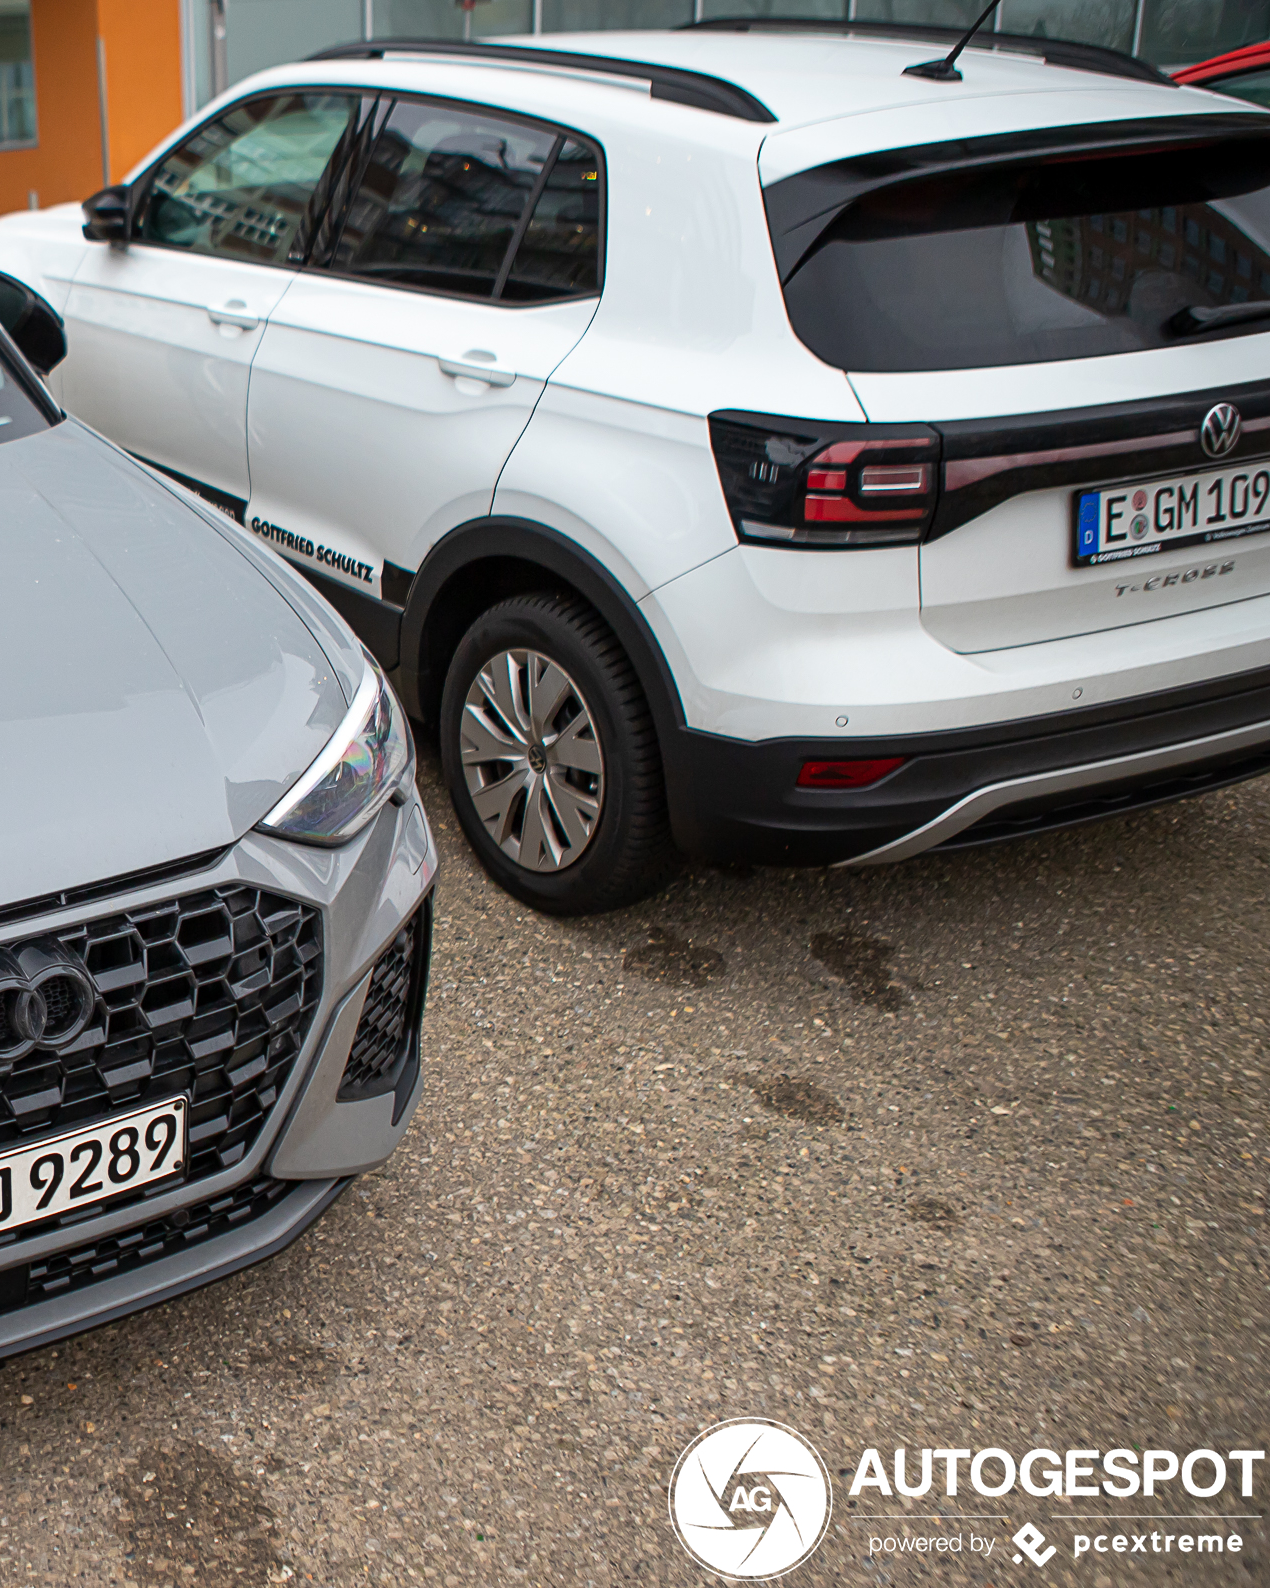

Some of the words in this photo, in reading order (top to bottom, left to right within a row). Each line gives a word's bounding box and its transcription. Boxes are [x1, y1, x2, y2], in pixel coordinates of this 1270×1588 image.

[1084, 530, 1094, 545] D
[1104, 495, 1128, 544] E
[1153, 481, 1200, 533] GM
[251, 516, 315, 557] GOTTFRIED
[316, 544, 375, 584] SCHULTZ
[1115, 560, 1236, 597] T-CROSS
[29, 1112, 179, 1212] 9289
